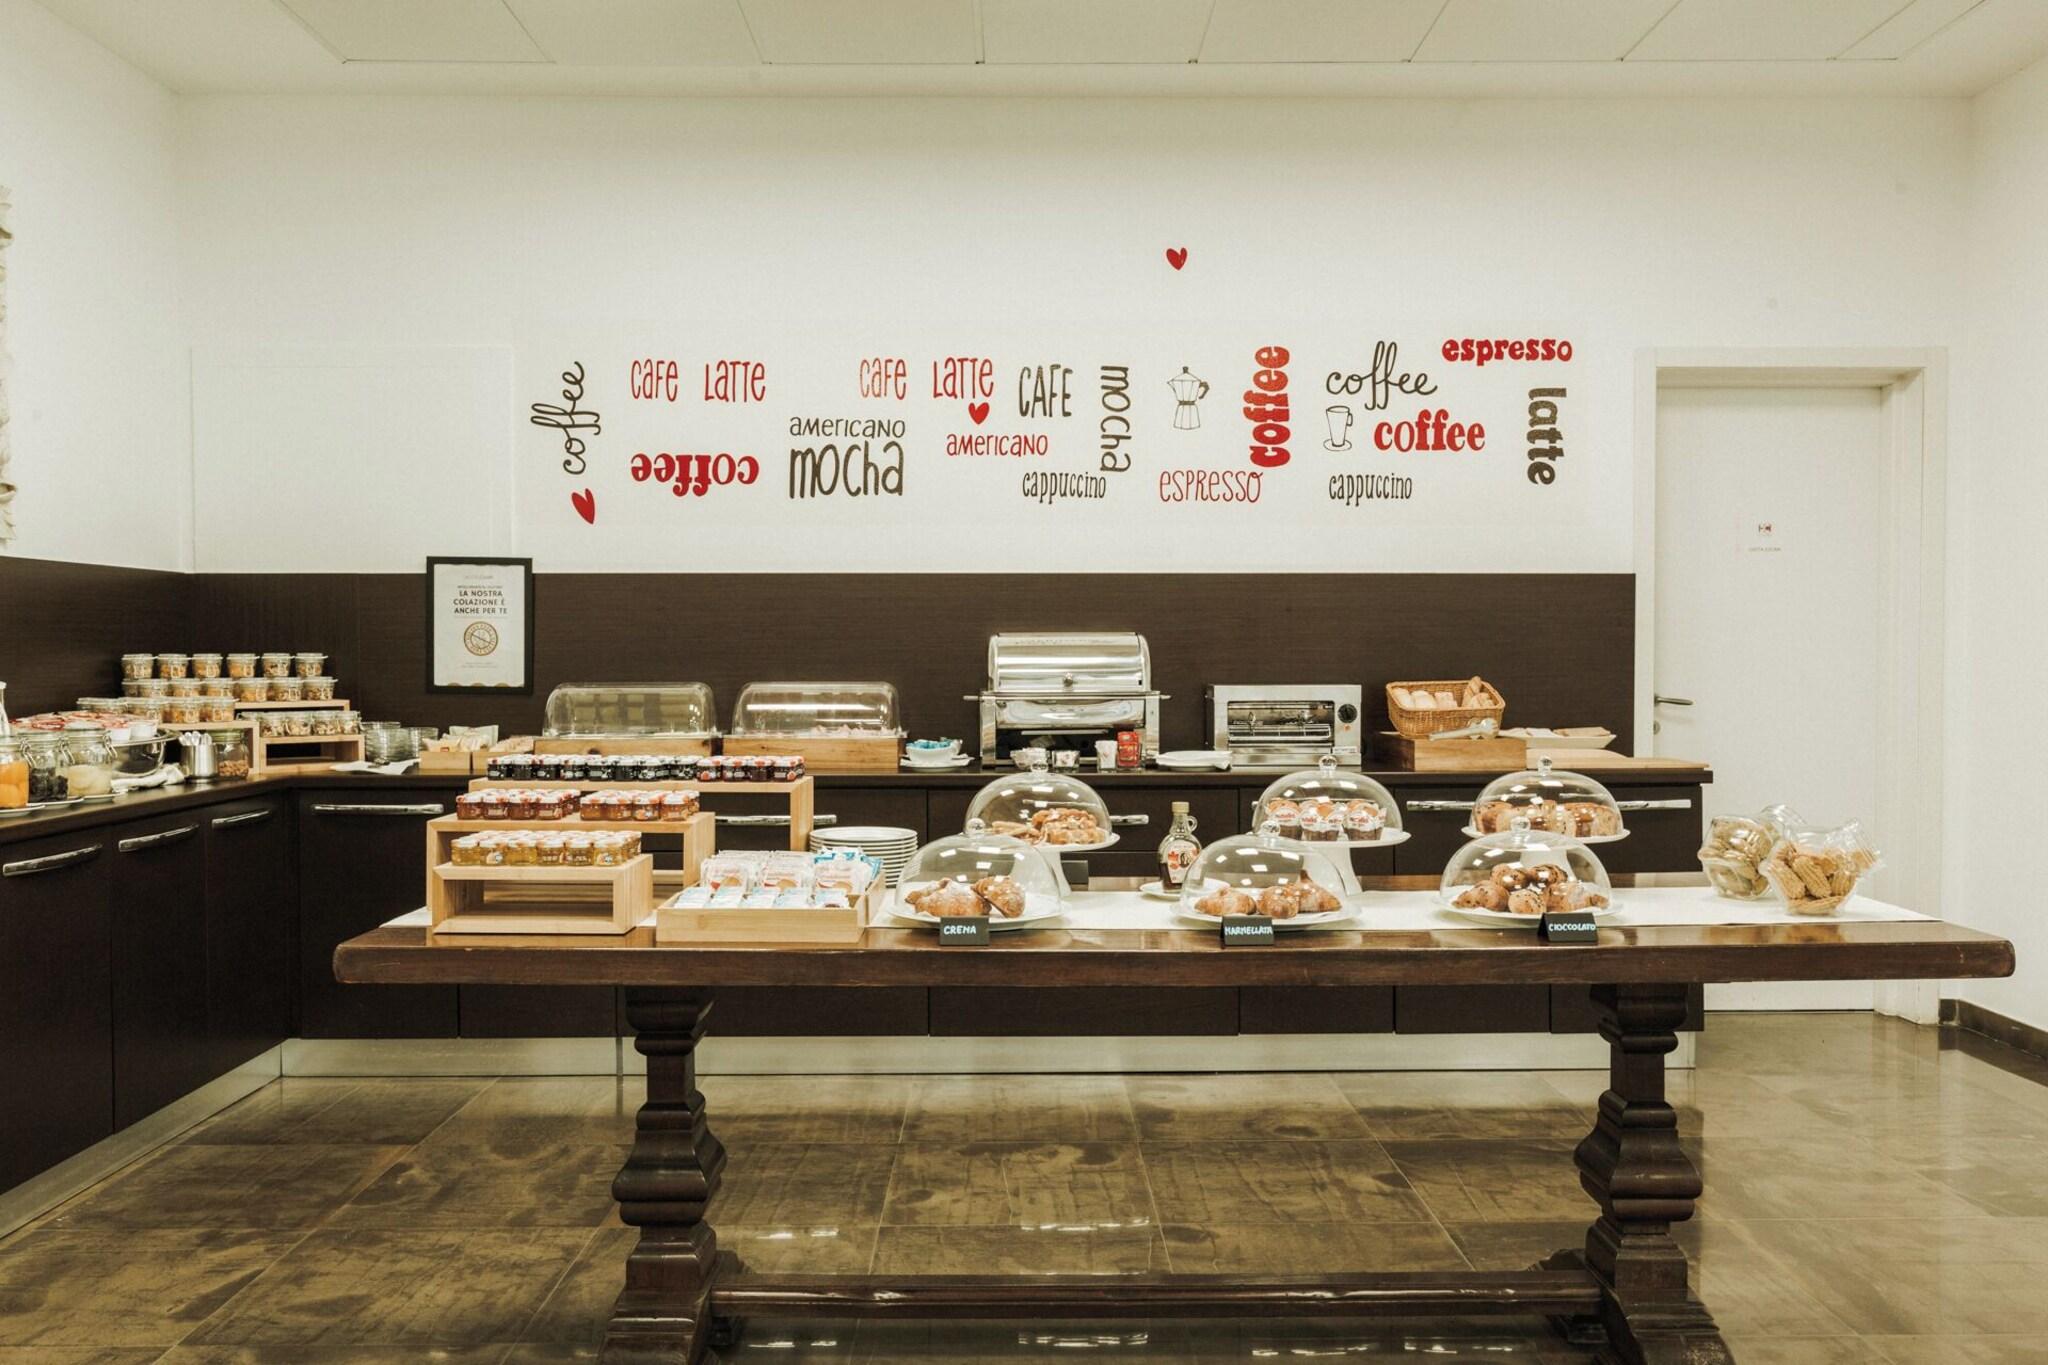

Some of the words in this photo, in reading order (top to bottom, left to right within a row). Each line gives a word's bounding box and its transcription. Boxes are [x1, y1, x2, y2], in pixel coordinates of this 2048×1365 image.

[1442, 338, 1573, 366] espresso
[1018, 363, 1073, 418] CAFE
[1326, 341, 1438, 411] coffee
[530, 360, 602, 475] coffee
[1100, 365, 1132, 473] mocha
[1243, 345, 1291, 467] coffee
[1373, 408, 1486, 452] coffee
[1527, 387, 1568, 486] latte
[630, 453, 760, 497] coffee
[789, 441, 904, 499] mocha
[1022, 471, 1107, 504] cappuccino
[1328, 473, 1413, 507] cappuccino
[453, 598, 498, 606] COLAZIONE
[943, 924, 977, 935] CREMA
[1224, 925, 1273, 936] MARMELLATA
[1548, 923, 1597, 931] CIOCCOLATO
